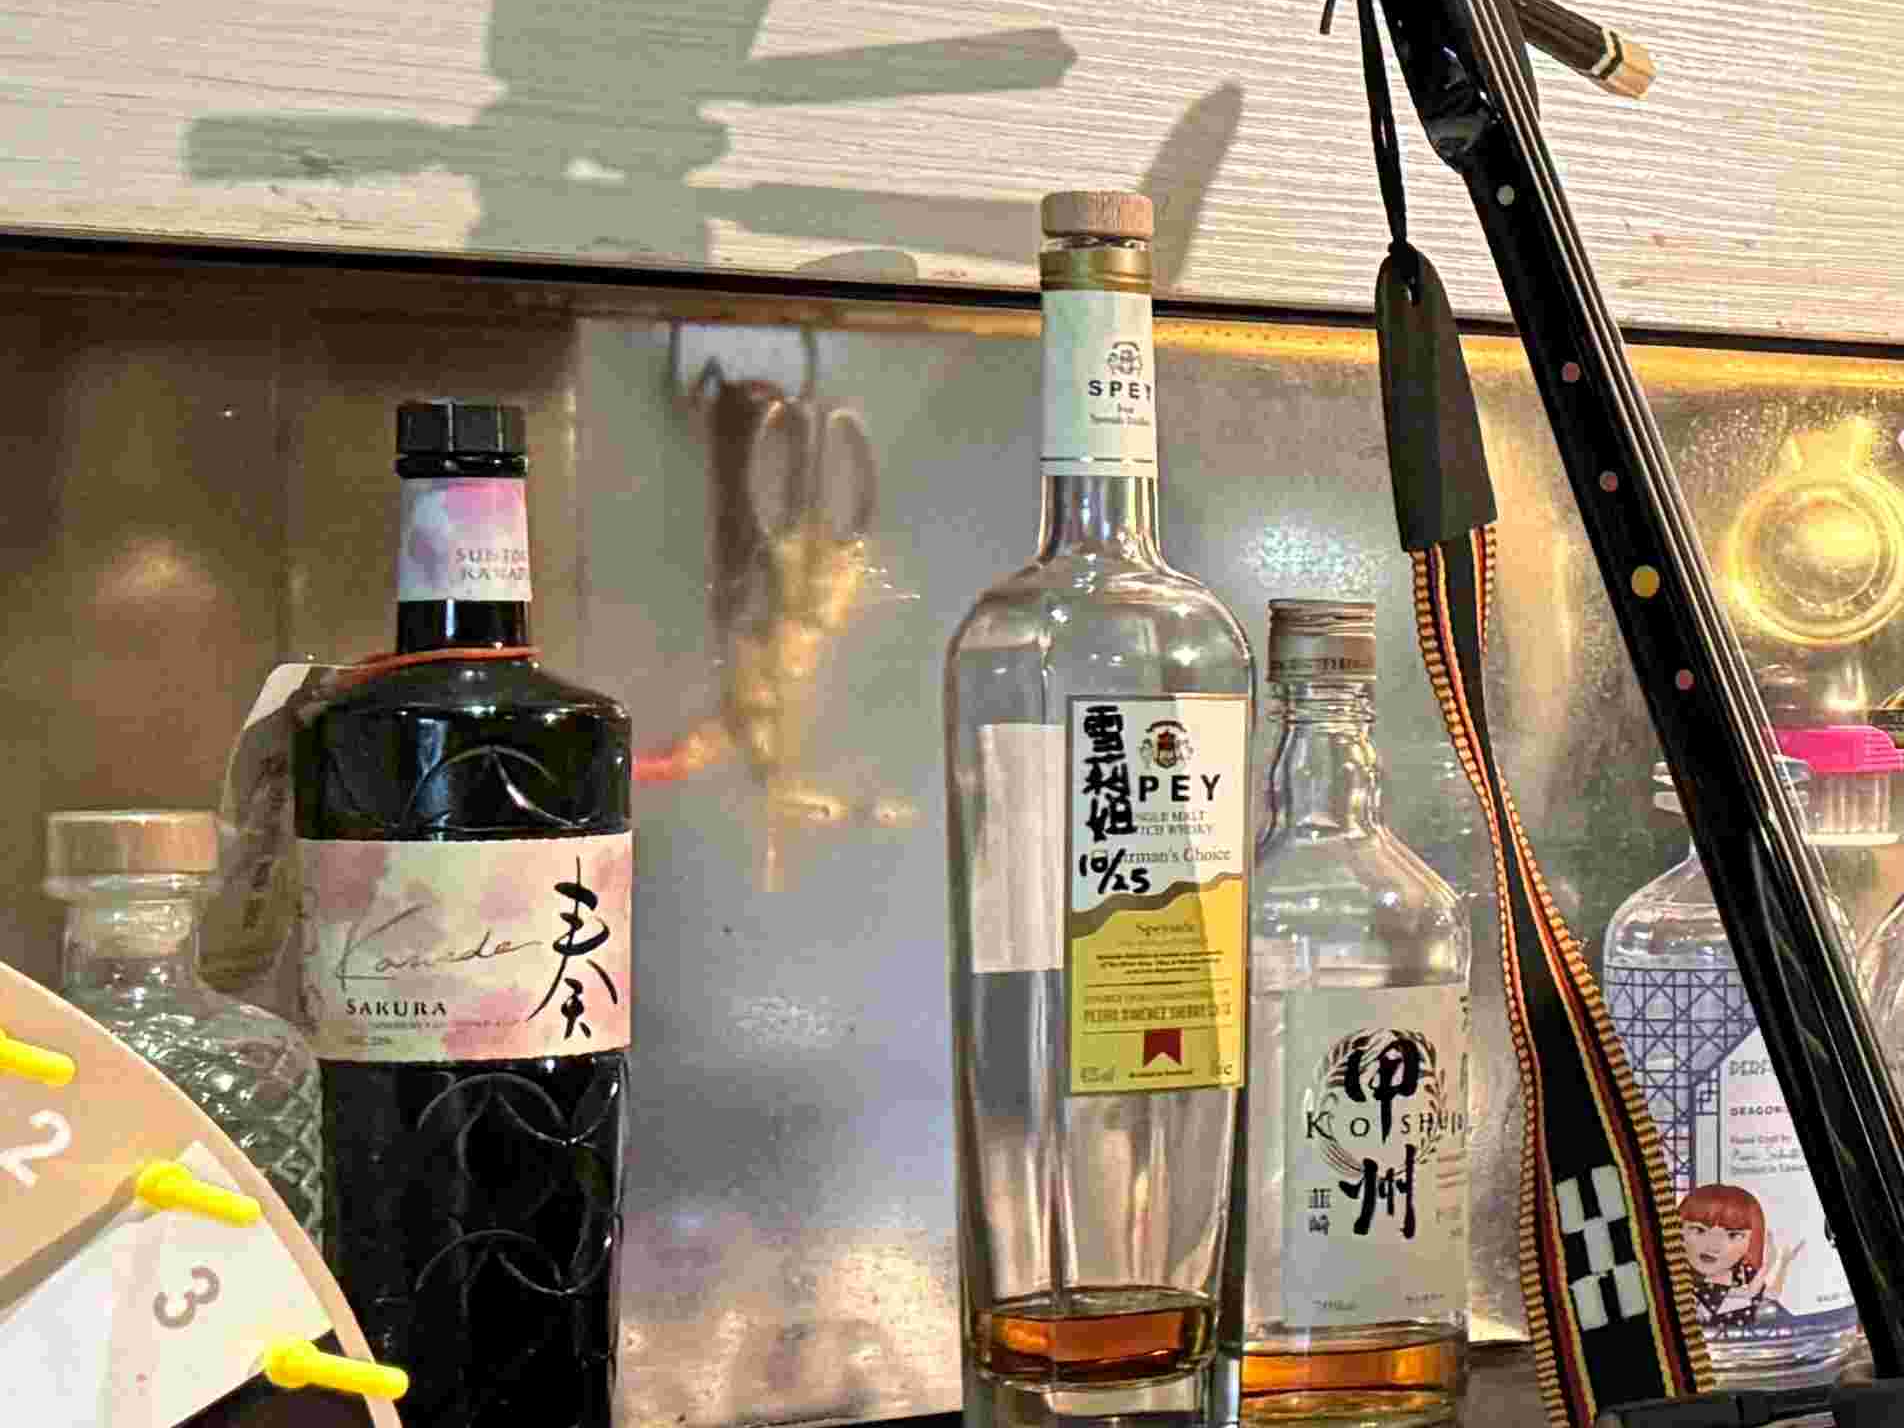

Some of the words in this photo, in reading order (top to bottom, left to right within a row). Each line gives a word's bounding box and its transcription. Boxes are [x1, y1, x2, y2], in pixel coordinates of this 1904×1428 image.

[1138, 773, 1222, 803] PEY
[346, 997, 448, 1018] SAKURA
[0, 1109, 72, 1189] 2
[153, 1266, 221, 1330] 3
